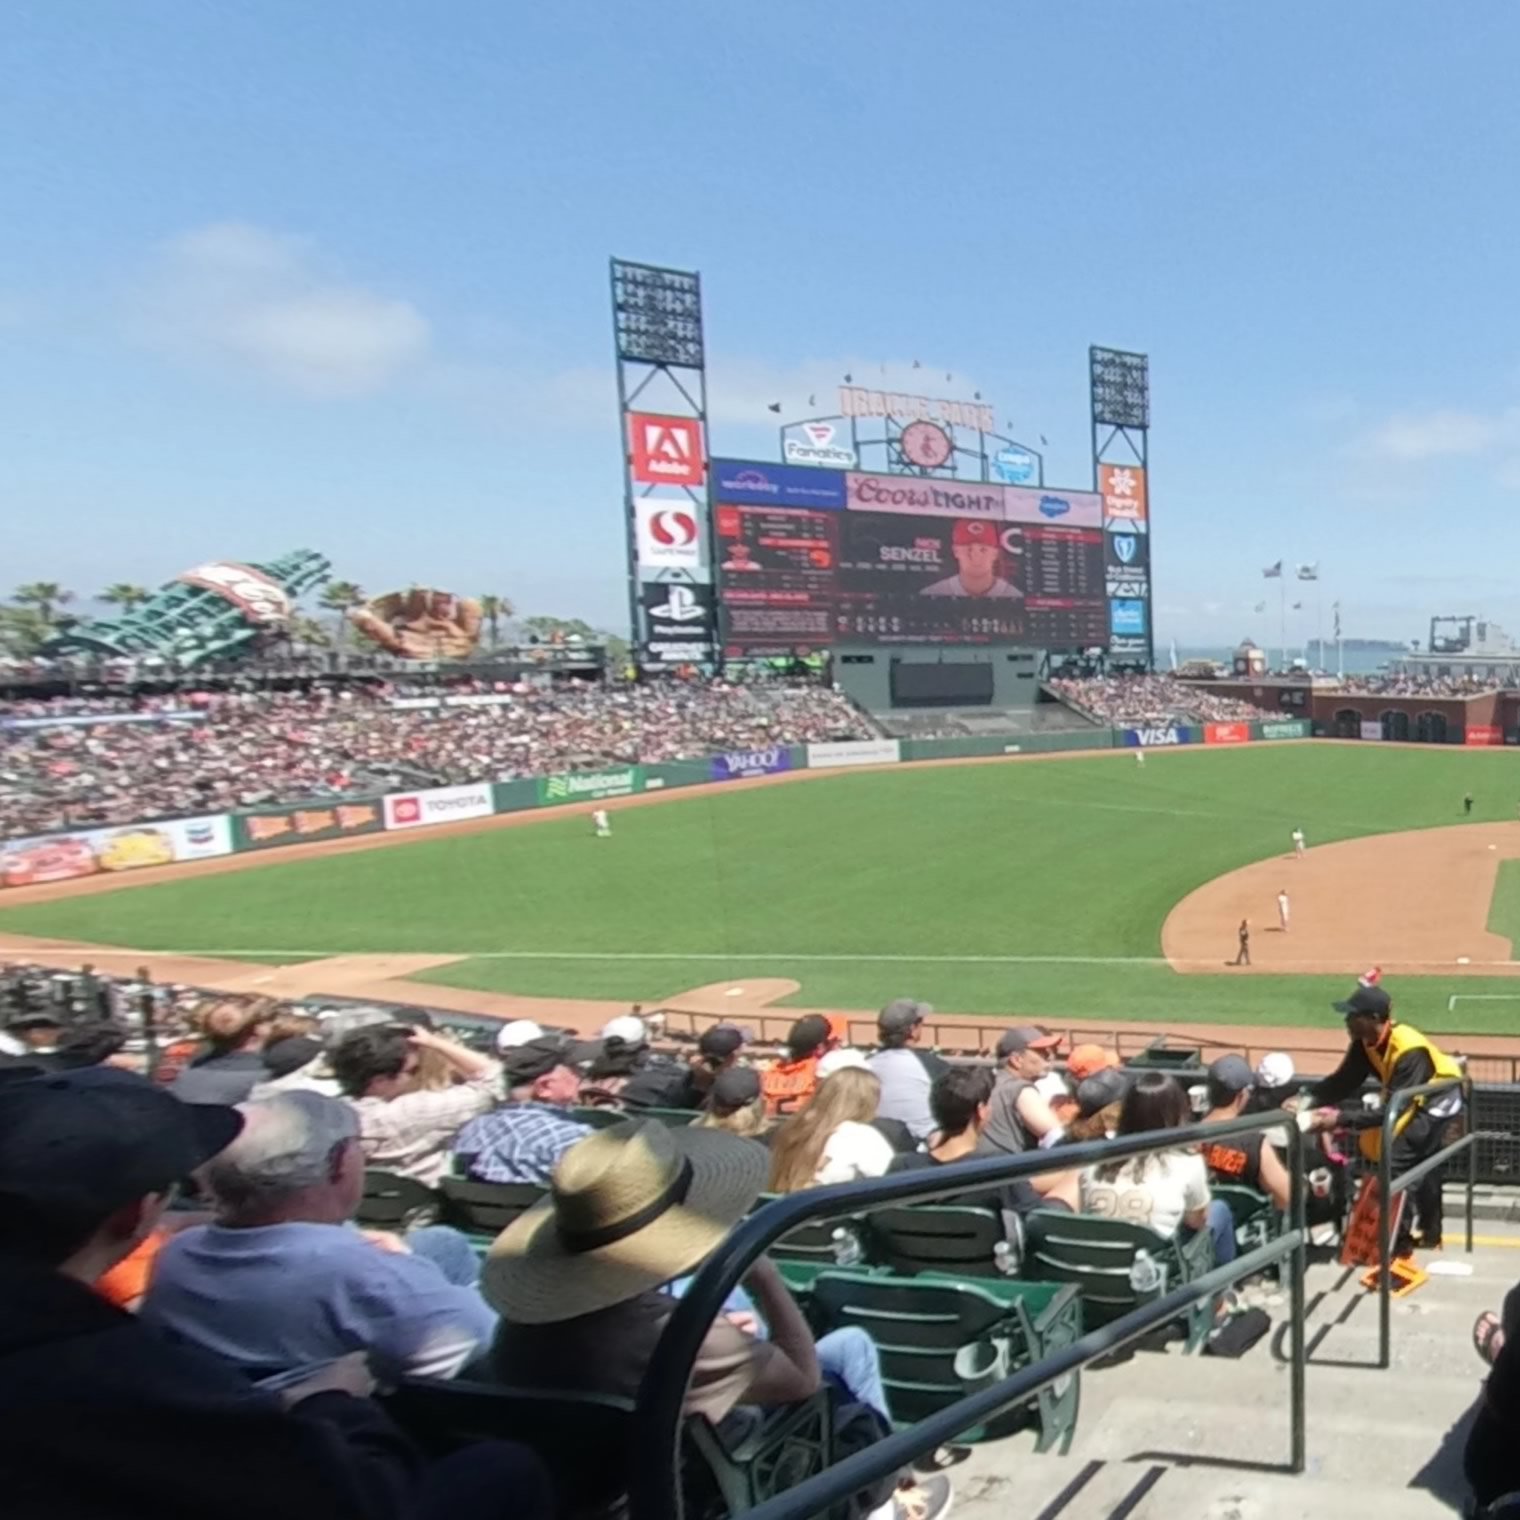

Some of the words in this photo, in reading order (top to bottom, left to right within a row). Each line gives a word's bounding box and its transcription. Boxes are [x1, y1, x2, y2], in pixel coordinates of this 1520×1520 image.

[787, 442, 854, 463] Fanatics
[854, 476, 930, 507] Coors
[930, 486, 997, 511] LIGHT
[880, 546, 942, 563] SENZEL
[1135, 727, 1179, 746] VISA
[724, 750, 779, 773] YAHOO!
[568, 769, 634, 793] National
[426, 795, 487, 812] TOYOTA
